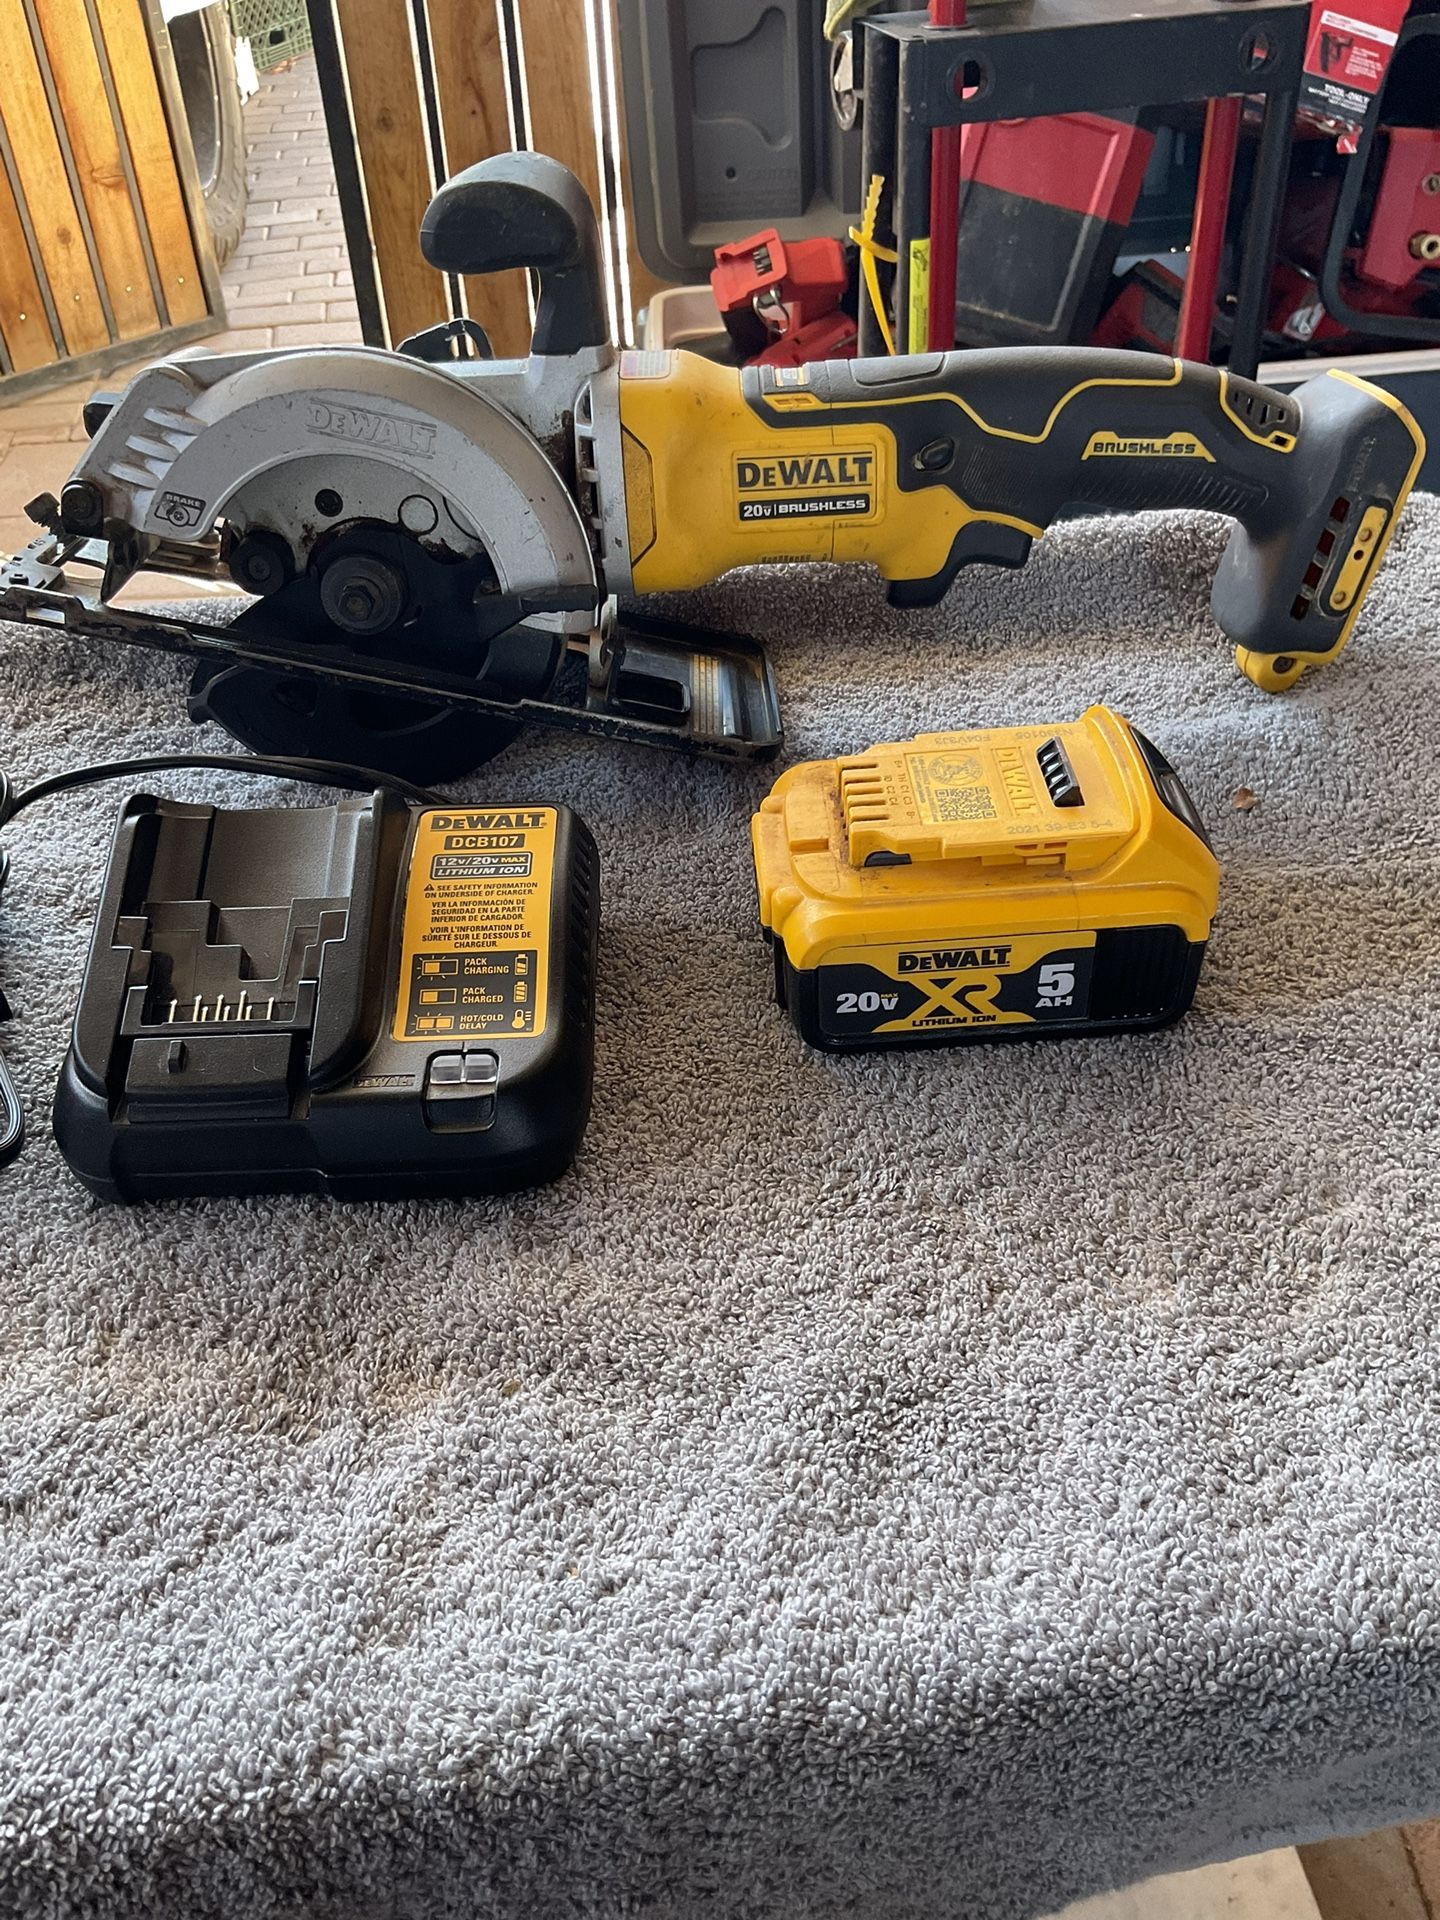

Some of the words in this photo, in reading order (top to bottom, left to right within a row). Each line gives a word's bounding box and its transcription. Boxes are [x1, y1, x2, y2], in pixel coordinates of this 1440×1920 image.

[1093, 442, 1196, 454] BRUSHLESS
[737, 457, 872, 488] DeWALT
[166, 494, 199, 507] BRAKE
[778, 500, 866, 514] BRUSHLESS
[431, 812, 545, 829] DeWALT
[451, 836, 519, 848] DCB107
[437, 868, 495, 876] LITHIUM
[499, 866, 525, 874] ION
[460, 899, 514, 907] INFORMACIÓN
[450, 924, 512, 933] L'INFORMATION
[464, 958, 487, 966] PACK
[899, 949, 1011, 971] DeWALT
[464, 966, 509, 974] CHARGING
[1037, 963, 1075, 997] 5
[463, 987, 486, 995] PACK
[905, 974, 1003, 1018] XR
[462, 995, 504, 1003] CHARGED
[1035, 996, 1073, 1008] AH
[460, 1014, 504, 1022] HOT/COLD
[912, 1017, 967, 1027] LITHIUM
[972, 1015, 997, 1023] ION
[459, 1022, 487, 1030] DELAY
